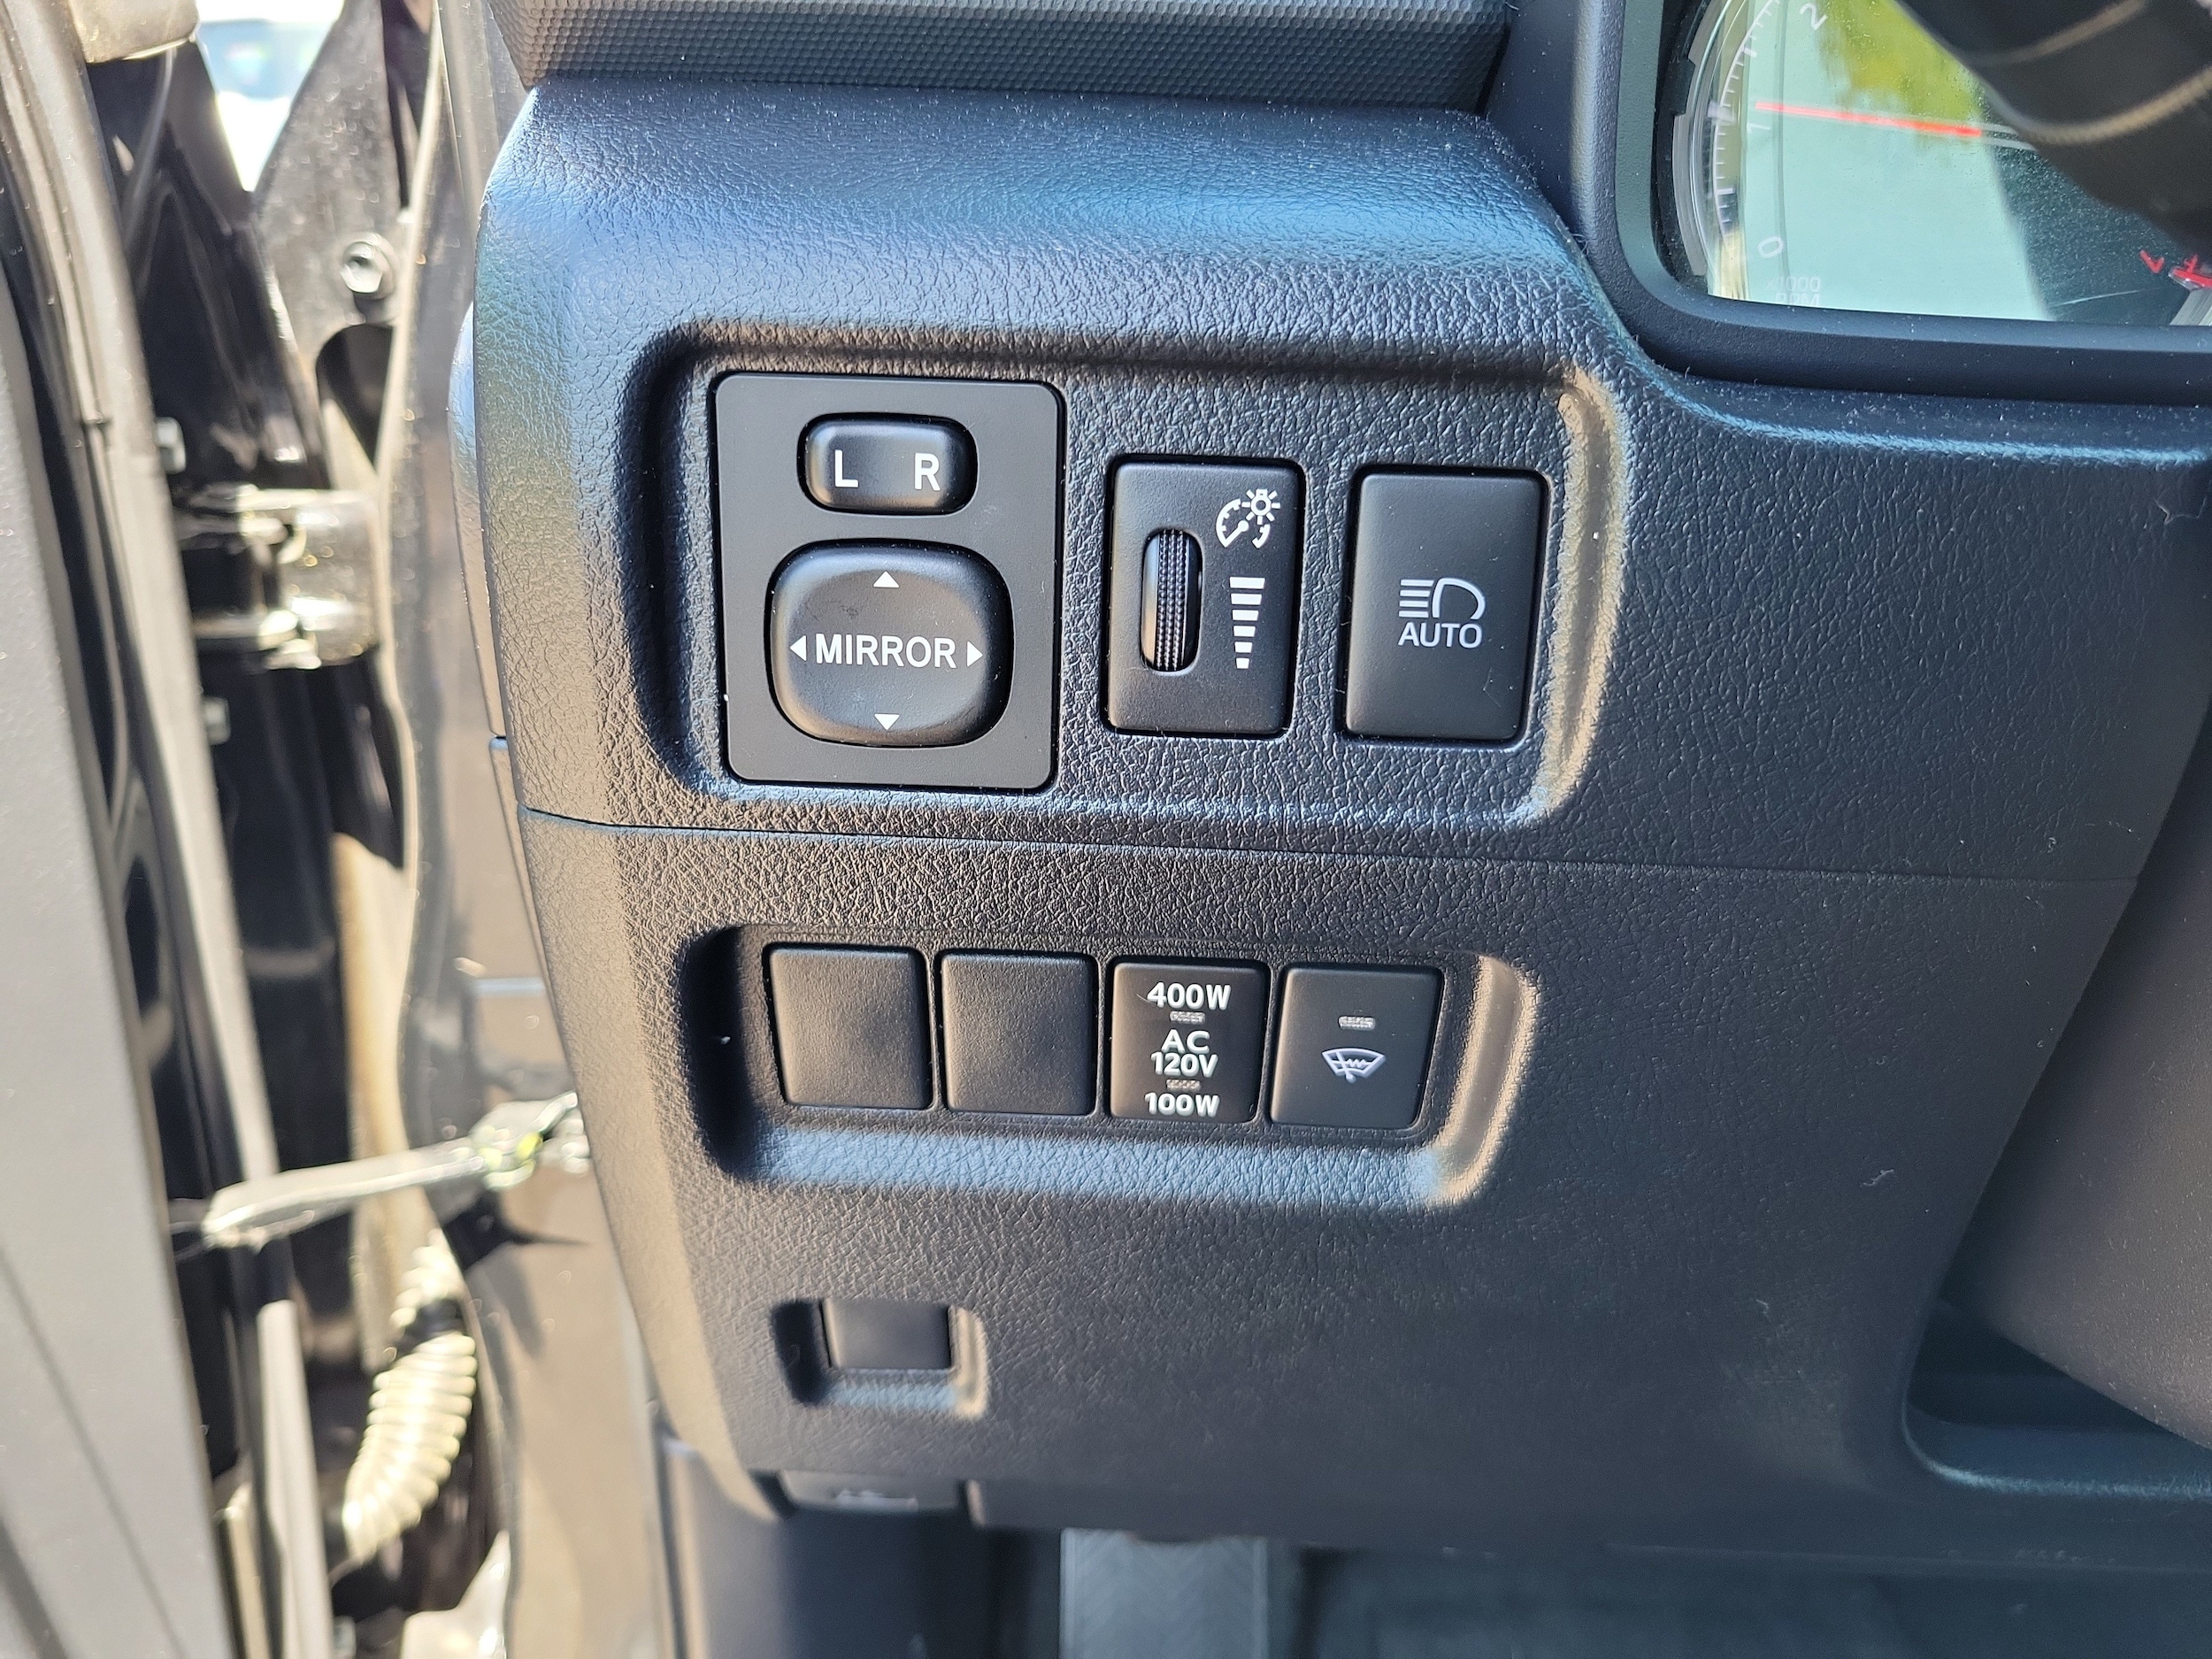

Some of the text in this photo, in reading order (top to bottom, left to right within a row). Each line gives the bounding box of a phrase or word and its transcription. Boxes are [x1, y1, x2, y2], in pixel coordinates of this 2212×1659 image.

[1800, 2, 1828, 31] 2
[1757, 235, 1784, 259] 0
[834, 449, 941, 491] L R
[1398, 622, 1483, 649] AUTO
[816, 633, 957, 669] MIRROR
[1147, 981, 1231, 1010] 400W
[1161, 1029, 1210, 1054] AC
[1150, 1051, 1218, 1078] 120V
[1145, 1092, 1220, 1118] 100W
